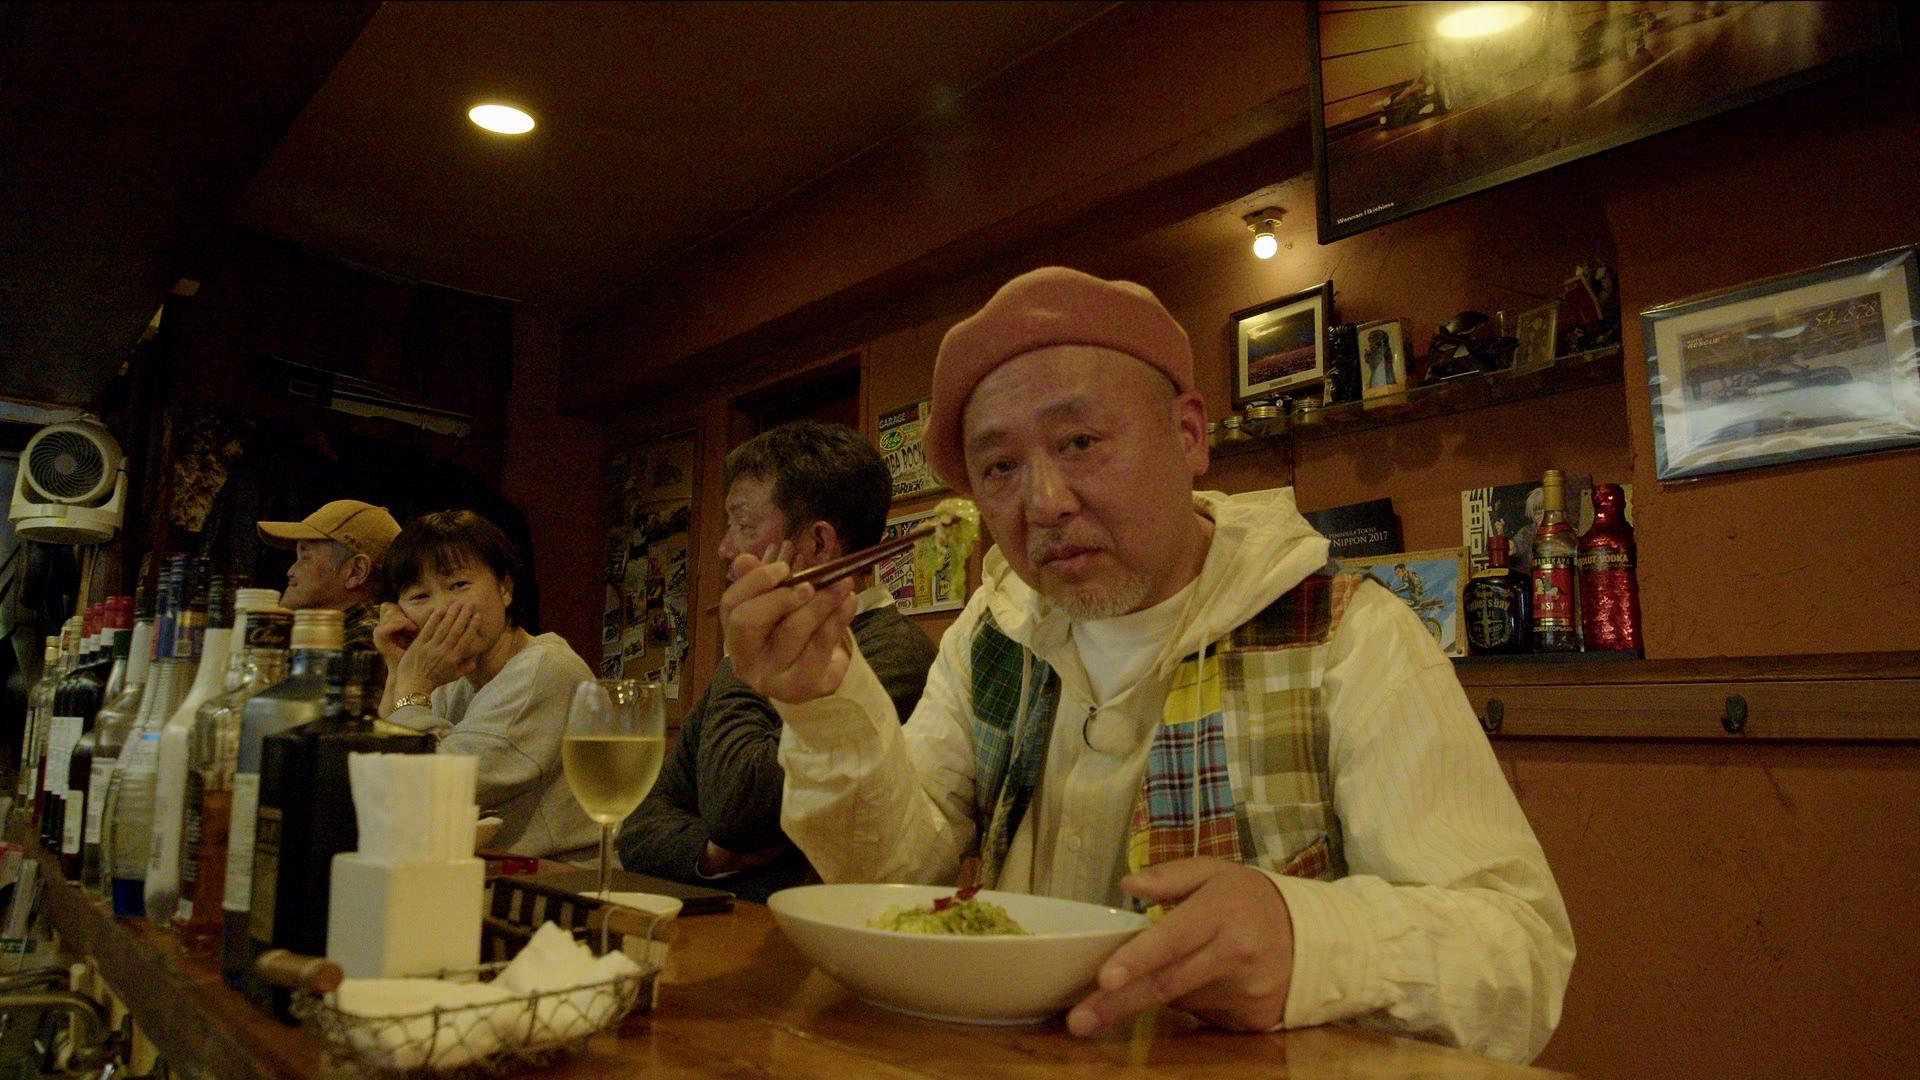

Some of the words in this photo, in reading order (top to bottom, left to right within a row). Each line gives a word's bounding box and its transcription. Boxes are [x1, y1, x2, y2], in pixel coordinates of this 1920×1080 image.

[1333, 534, 1366, 547] NIPPON
[1368, 530, 1388, 543] 2017
[1599, 554, 1629, 563] VODKA
